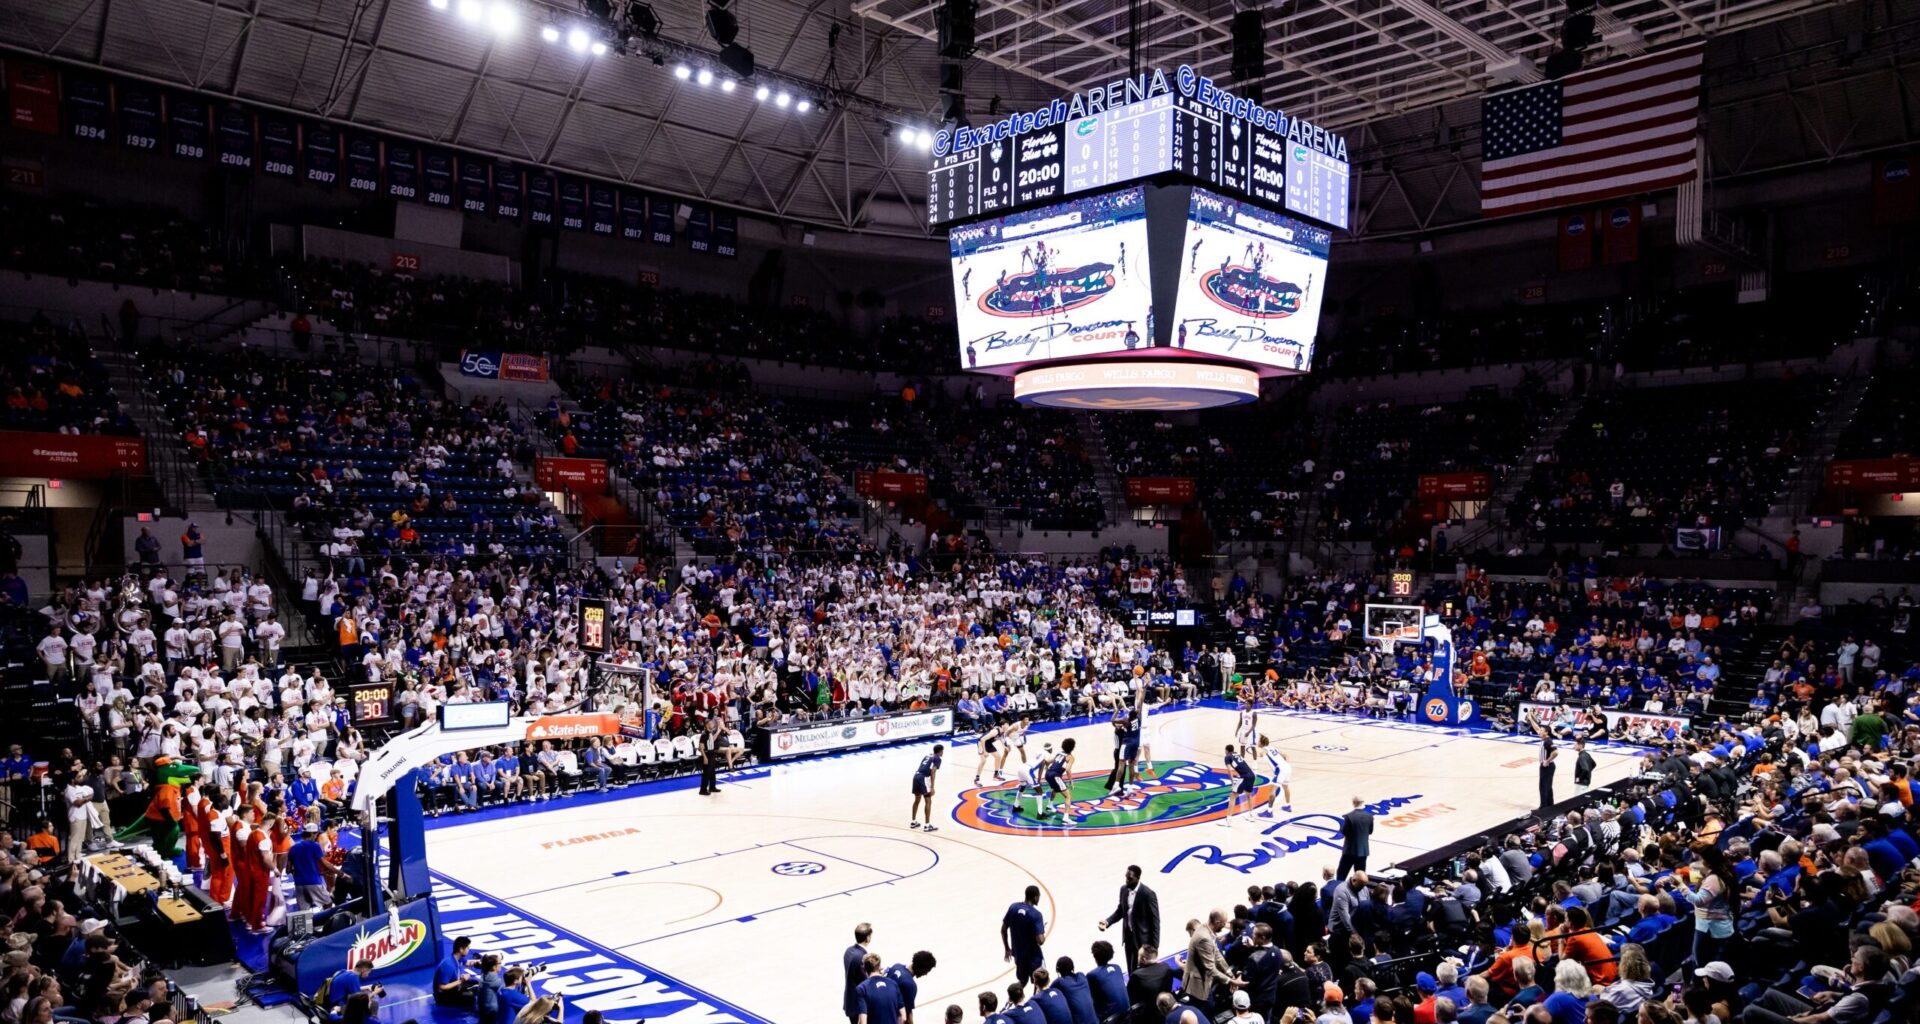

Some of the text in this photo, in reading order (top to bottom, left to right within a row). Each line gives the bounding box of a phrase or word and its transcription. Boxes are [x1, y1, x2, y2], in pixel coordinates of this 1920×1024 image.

[952, 67, 1170, 153] Exactech ARENA
[1129, 97, 1168, 115] PTS FLS
[1190, 100, 1218, 120] PTS FLS
[1176, 111, 1217, 135] 2 0 0
[1197, 76, 1348, 162] Exactech ARENA
[75, 124, 106, 140] 1994
[1176, 123, 1217, 147] 11 0 0
[126, 134, 156, 149] 1997
[1021, 131, 1057, 150] Florida
[1175, 135, 1217, 158] 21 0 0
[176, 143, 204, 158] 1998
[945, 149, 975, 165] PTS FLS
[1082, 144, 1090, 160] 0
[1232, 145, 1239, 161] 0
[221, 152, 251, 167] 2004
[1174, 147, 1217, 170] 24 0 0
[265, 161, 294, 175] 2006
[931, 163, 974, 182] 2 0 0
[992, 167, 1000, 182] 0
[1174, 159, 1217, 182] 44 0 0
[1225, 161, 1236, 173] FLS
[11, 168, 36, 184] 211
[308, 169, 335, 183] 2007
[1019, 163, 1060, 187] 20:00
[1225, 175, 1245, 190] TOL 4
[1253, 164, 1283, 188] 20:00
[350, 178, 376, 191] 2008
[390, 184, 415, 198] 2009
[930, 174, 974, 193] 11 0 0
[984, 182, 1008, 196] FLS 0
[428, 192, 450, 205] 2010
[930, 184, 974, 203] 21 0 0
[1021, 185, 1055, 201] 1st HALF
[1266, 190, 1280, 202] HALF
[464, 199, 485, 211] 2012
[929, 195, 974, 214] 24 0 0
[984, 195, 1008, 210] TOL 4
[498, 204, 518, 217] 2013
[532, 210, 551, 223] 2014
[929, 206, 974, 224] 44 0 0
[563, 217, 583, 229] 2015
[594, 222, 612, 234] 2016
[624, 227, 642, 239] 2017
[653, 232, 671, 244] 2018
[691, 239, 708, 252] 2021
[718, 244, 735, 257] 2022
[1826, 247, 1849, 259] 219
[396, 256, 417, 268] 212
[640, 271, 657, 284] 213
[1526, 287, 1543, 298] 218
[929, 307, 944, 316] 215
[1072, 330, 1126, 343] COURT
[1264, 344, 1297, 357] COURT
[1103, 369, 1137, 380] WELLS
[1142, 370, 1176, 380] FARGO
[1196, 371, 1224, 382] WELLS
[1392, 573, 1411, 581] 20:00
[1395, 582, 1409, 594] 30
[1151, 612, 1174, 620] 20:00
[586, 622, 602, 648] 30
[1434, 667, 1444, 681] F
[355, 688, 388, 702] 20:00
[364, 702, 382, 718] 30
[1430, 705, 1444, 716] 76
[1131, 718, 1139, 731] 21
[381, 756, 407, 780] SPALDING
[923, 757, 929, 766] 2
[1380, 802, 1457, 828] COURT
[541, 827, 641, 850] FLORIDA
